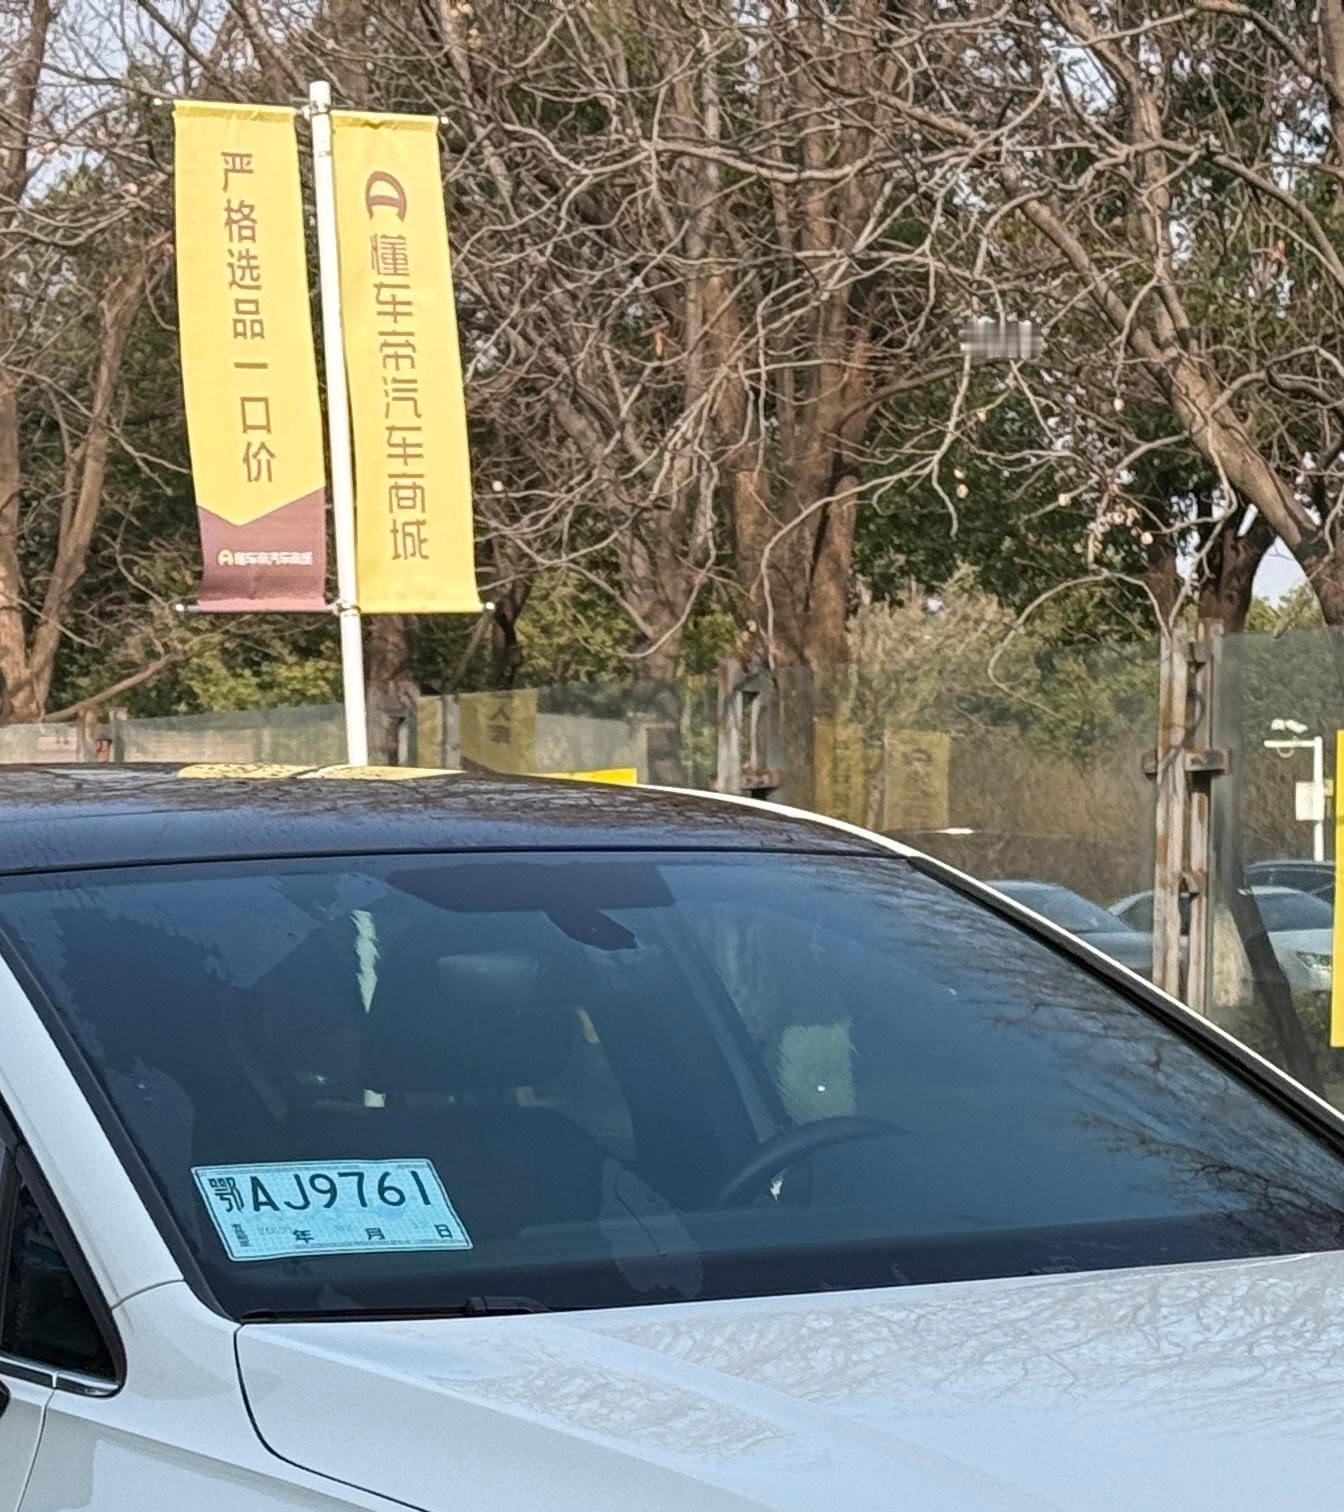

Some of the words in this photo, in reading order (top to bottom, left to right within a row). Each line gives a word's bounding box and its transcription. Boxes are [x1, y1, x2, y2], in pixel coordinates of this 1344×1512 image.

[220, 151, 276, 483] 严格选品一口价
[369, 233, 429, 561] 懂车帝汽车商城
[208, 1170, 431, 1213] 鄂AJ9761
[292, 1228, 314, 1244] 年
[365, 1227, 385, 1241] 月
[434, 1223, 453, 1240] 日
